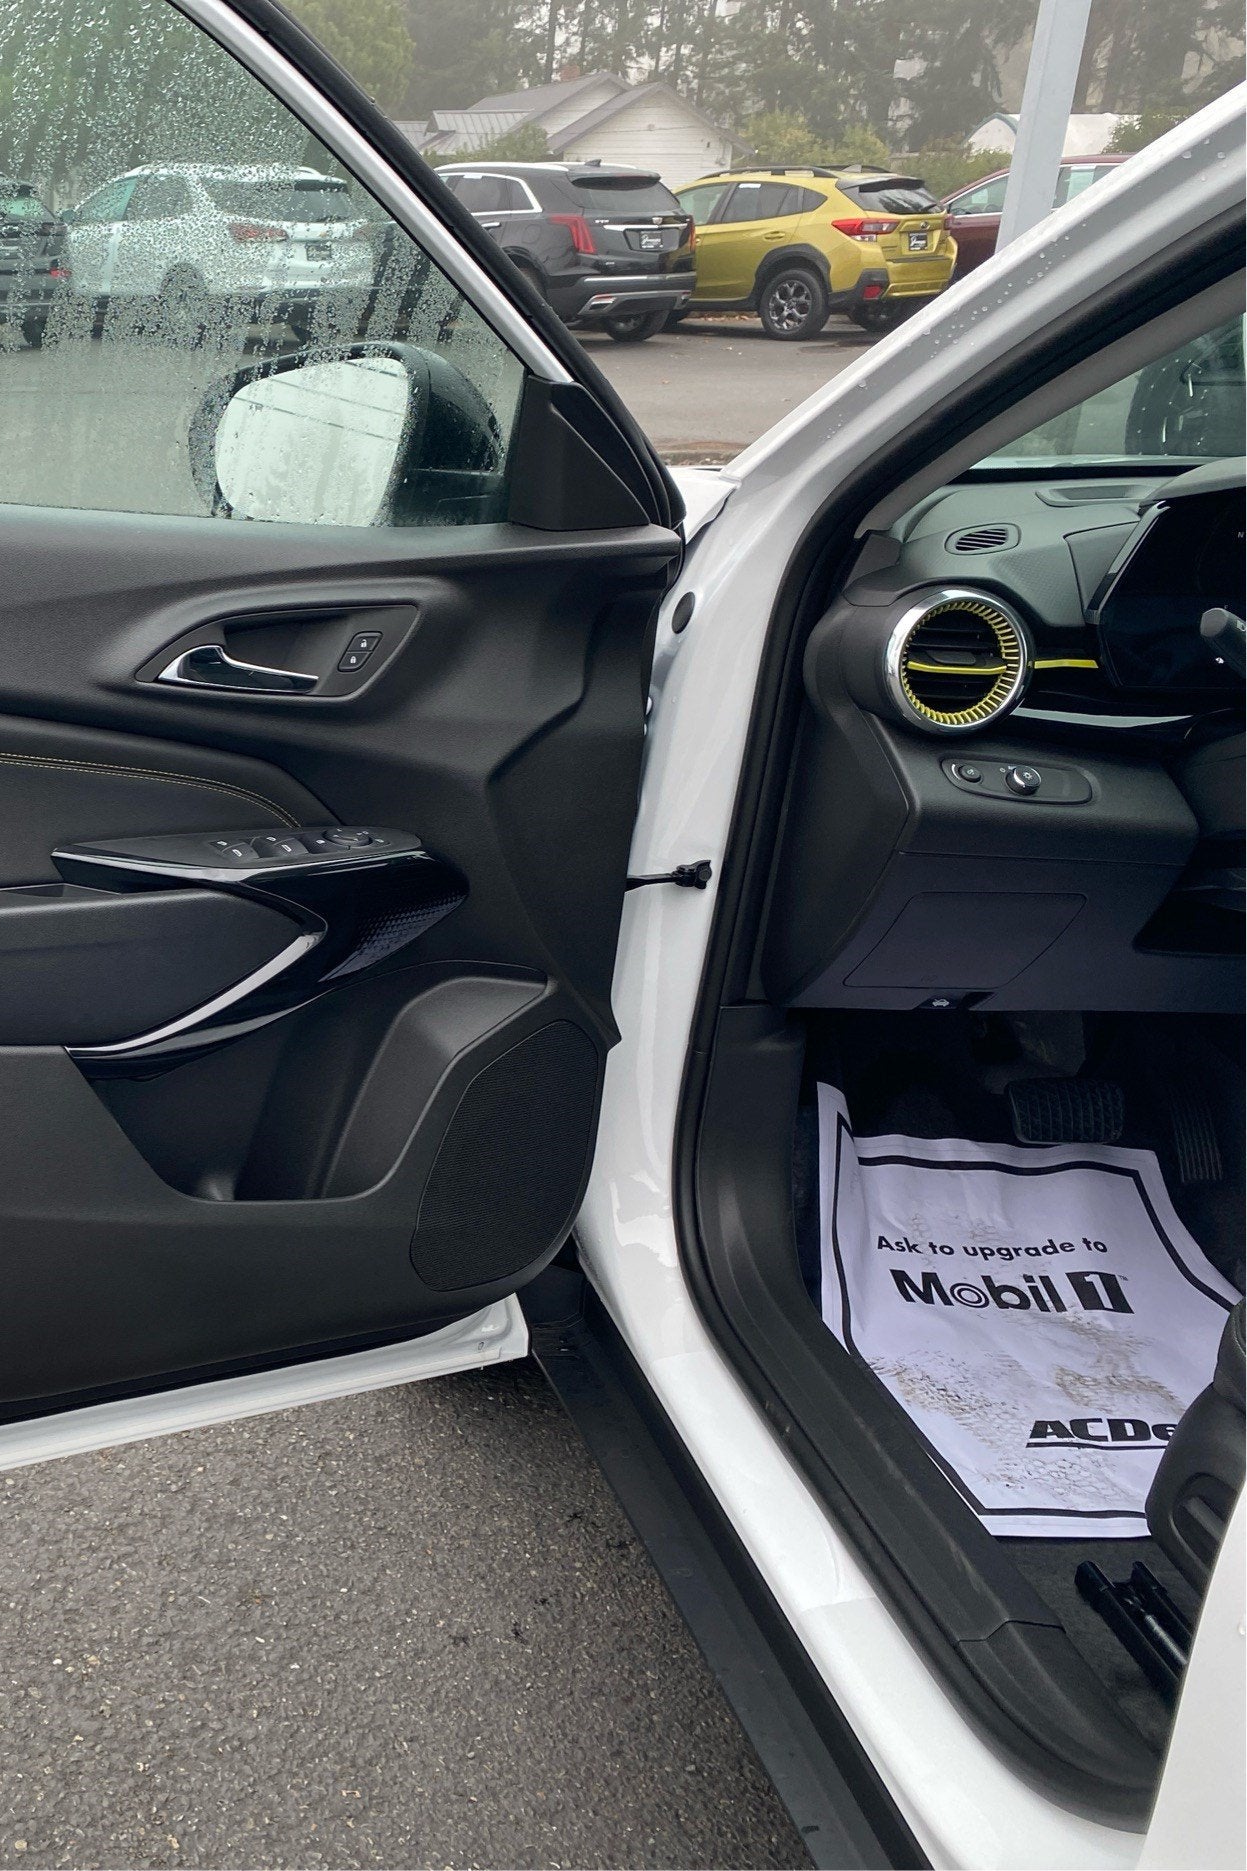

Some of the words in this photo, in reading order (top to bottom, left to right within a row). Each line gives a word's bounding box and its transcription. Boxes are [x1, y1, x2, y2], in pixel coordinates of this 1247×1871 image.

[877, 1235, 923, 1254] Ask
[928, 1241, 955, 1256] to
[962, 1238, 1076, 1261] upgrade
[1082, 1237, 1108, 1254] to
[889, 1268, 1068, 1313] Mobil
